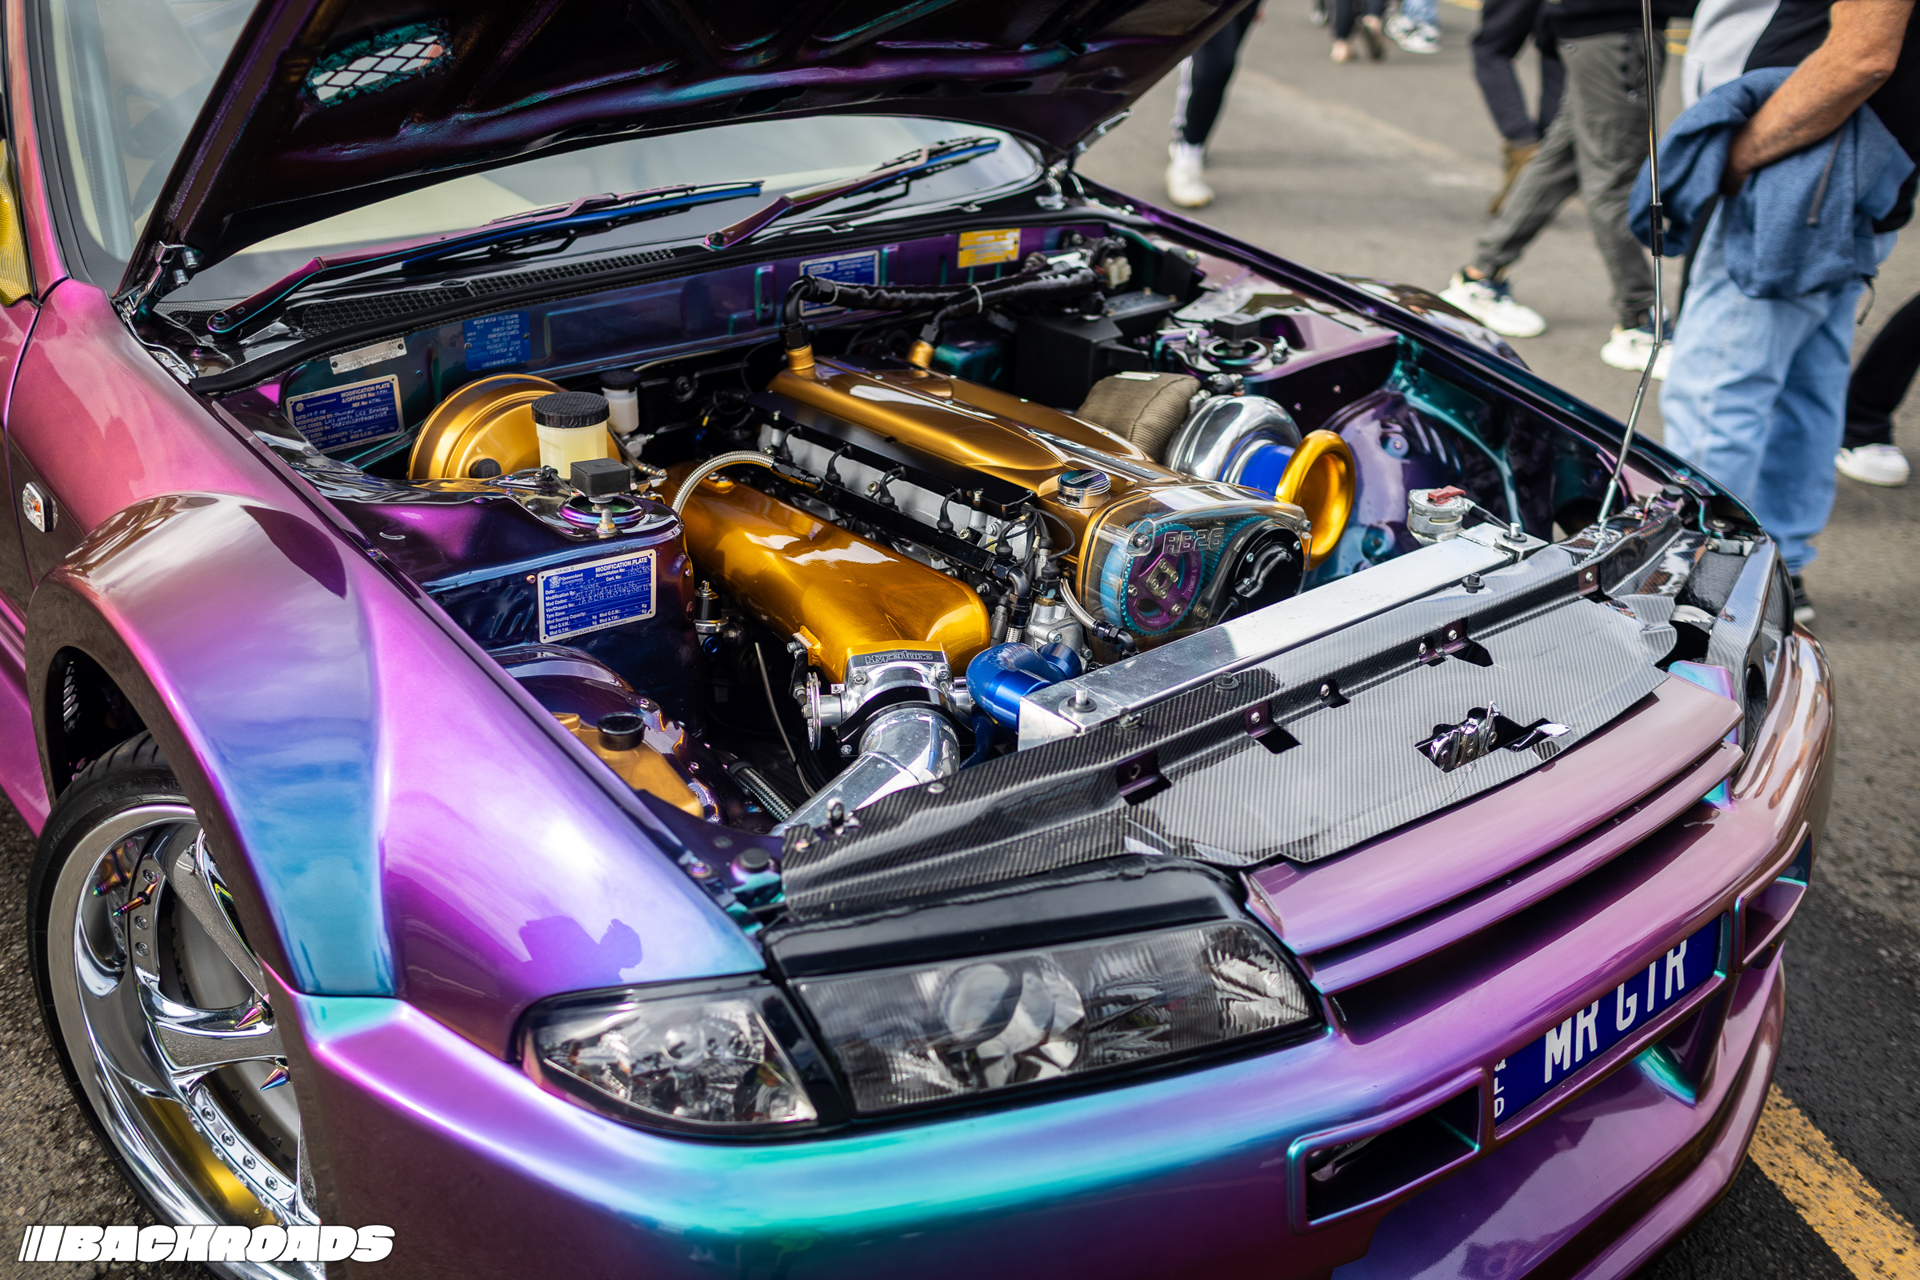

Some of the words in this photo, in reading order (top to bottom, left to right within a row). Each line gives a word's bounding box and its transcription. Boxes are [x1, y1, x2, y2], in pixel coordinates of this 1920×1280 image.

[376, 382, 390, 391] PLATE
[1162, 527, 1225, 554] RB26
[595, 560, 632, 573] MODIFICATION
[632, 556, 648, 567] PLATE
[865, 649, 934, 666] Hypertune
[1544, 999, 1599, 1084] MR
